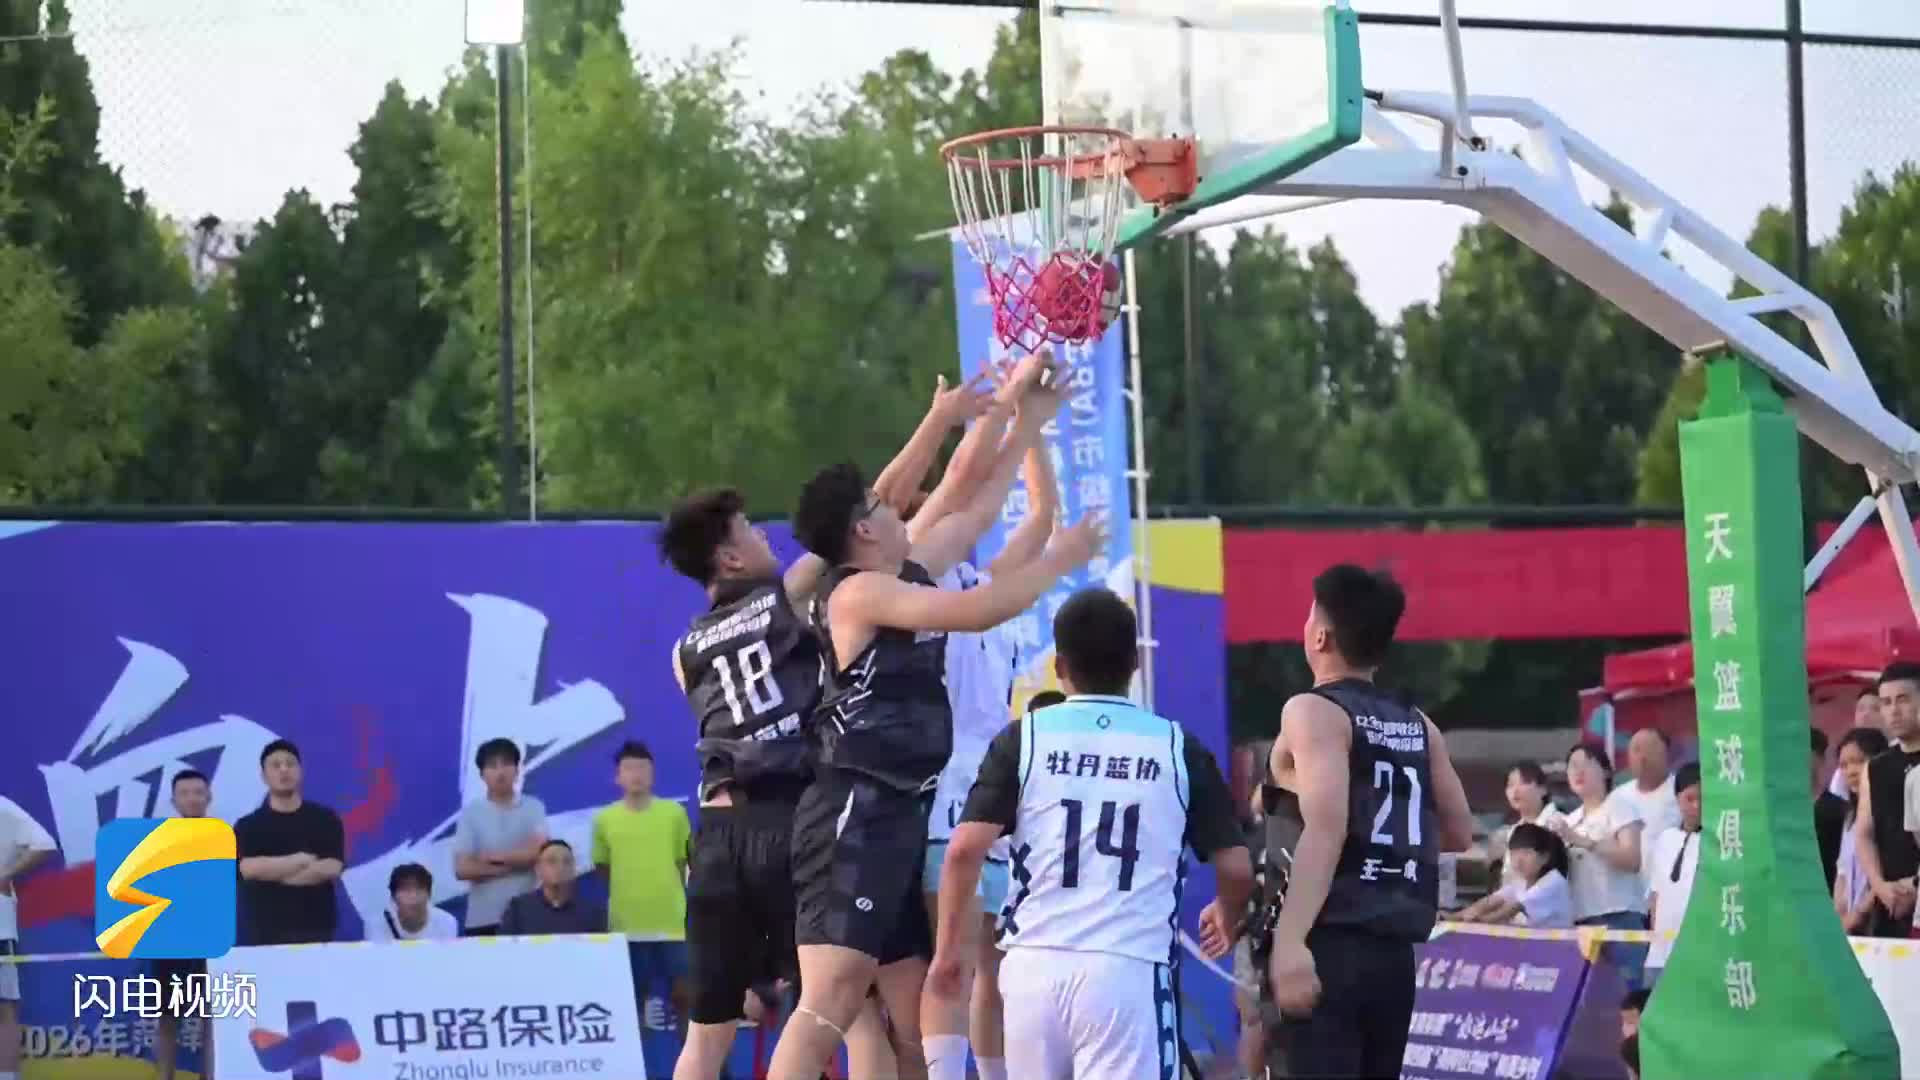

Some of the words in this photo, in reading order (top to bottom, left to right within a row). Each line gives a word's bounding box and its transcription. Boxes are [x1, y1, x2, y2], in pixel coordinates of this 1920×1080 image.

[712, 640, 784, 726] 18
[1046, 750, 1161, 782] 牡丹篮协
[1371, 760, 1422, 846] 21
[1704, 512, 1756, 1009] 天翼篮球俱乐部
[1061, 798, 1140, 892] 14
[373, 1002, 616, 1053] 中路保险
[393, 1057, 489, 1080] Zhonglu
[495, 1056, 604, 1077] Insurance
